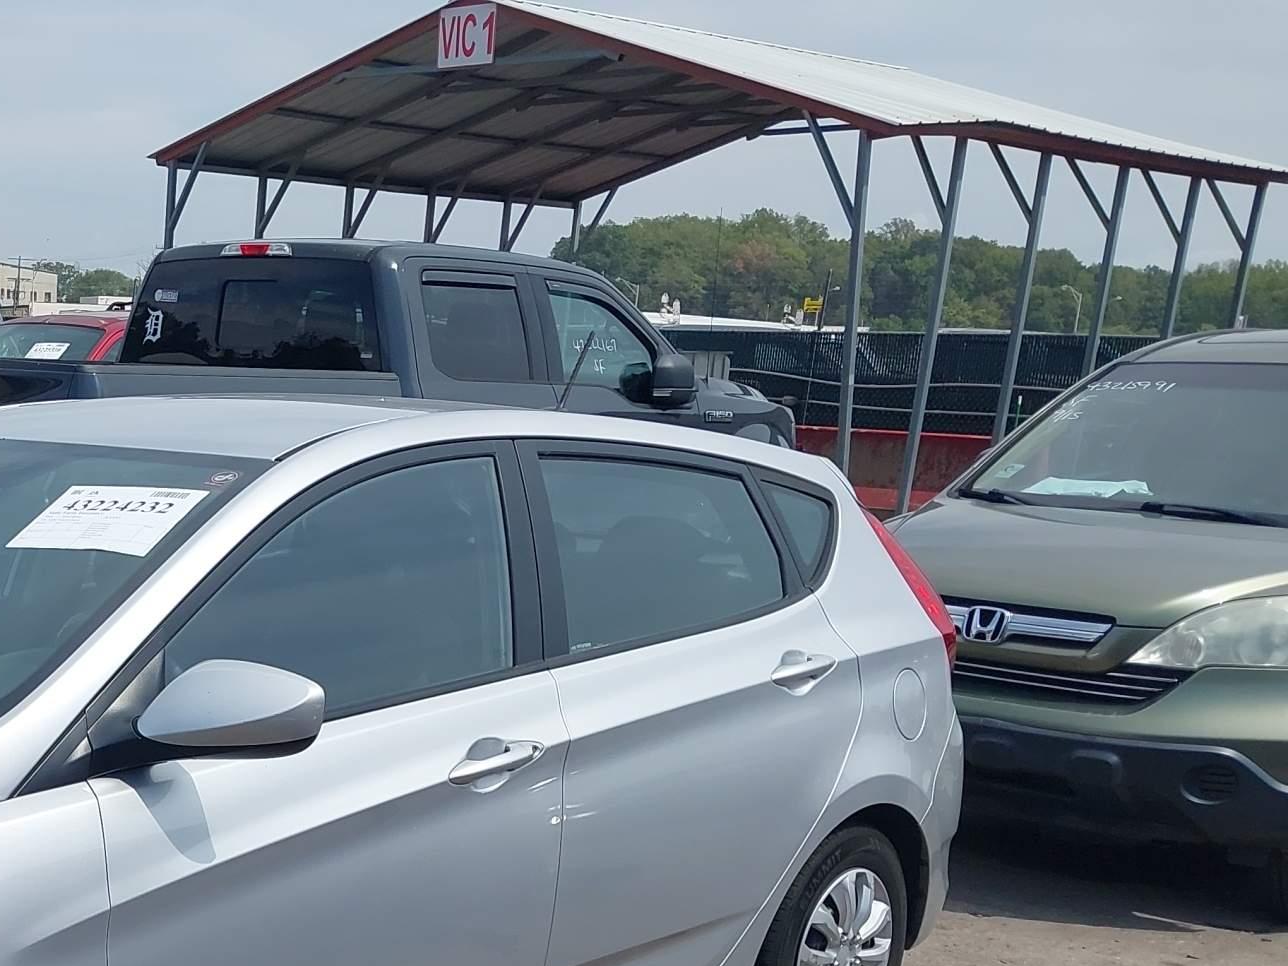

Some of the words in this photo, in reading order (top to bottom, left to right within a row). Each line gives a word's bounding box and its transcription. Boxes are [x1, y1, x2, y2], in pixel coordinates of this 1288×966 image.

[441, 13, 477, 60] VIC
[482, 11, 495, 56] 1
[62, 499, 175, 514] 43224232
